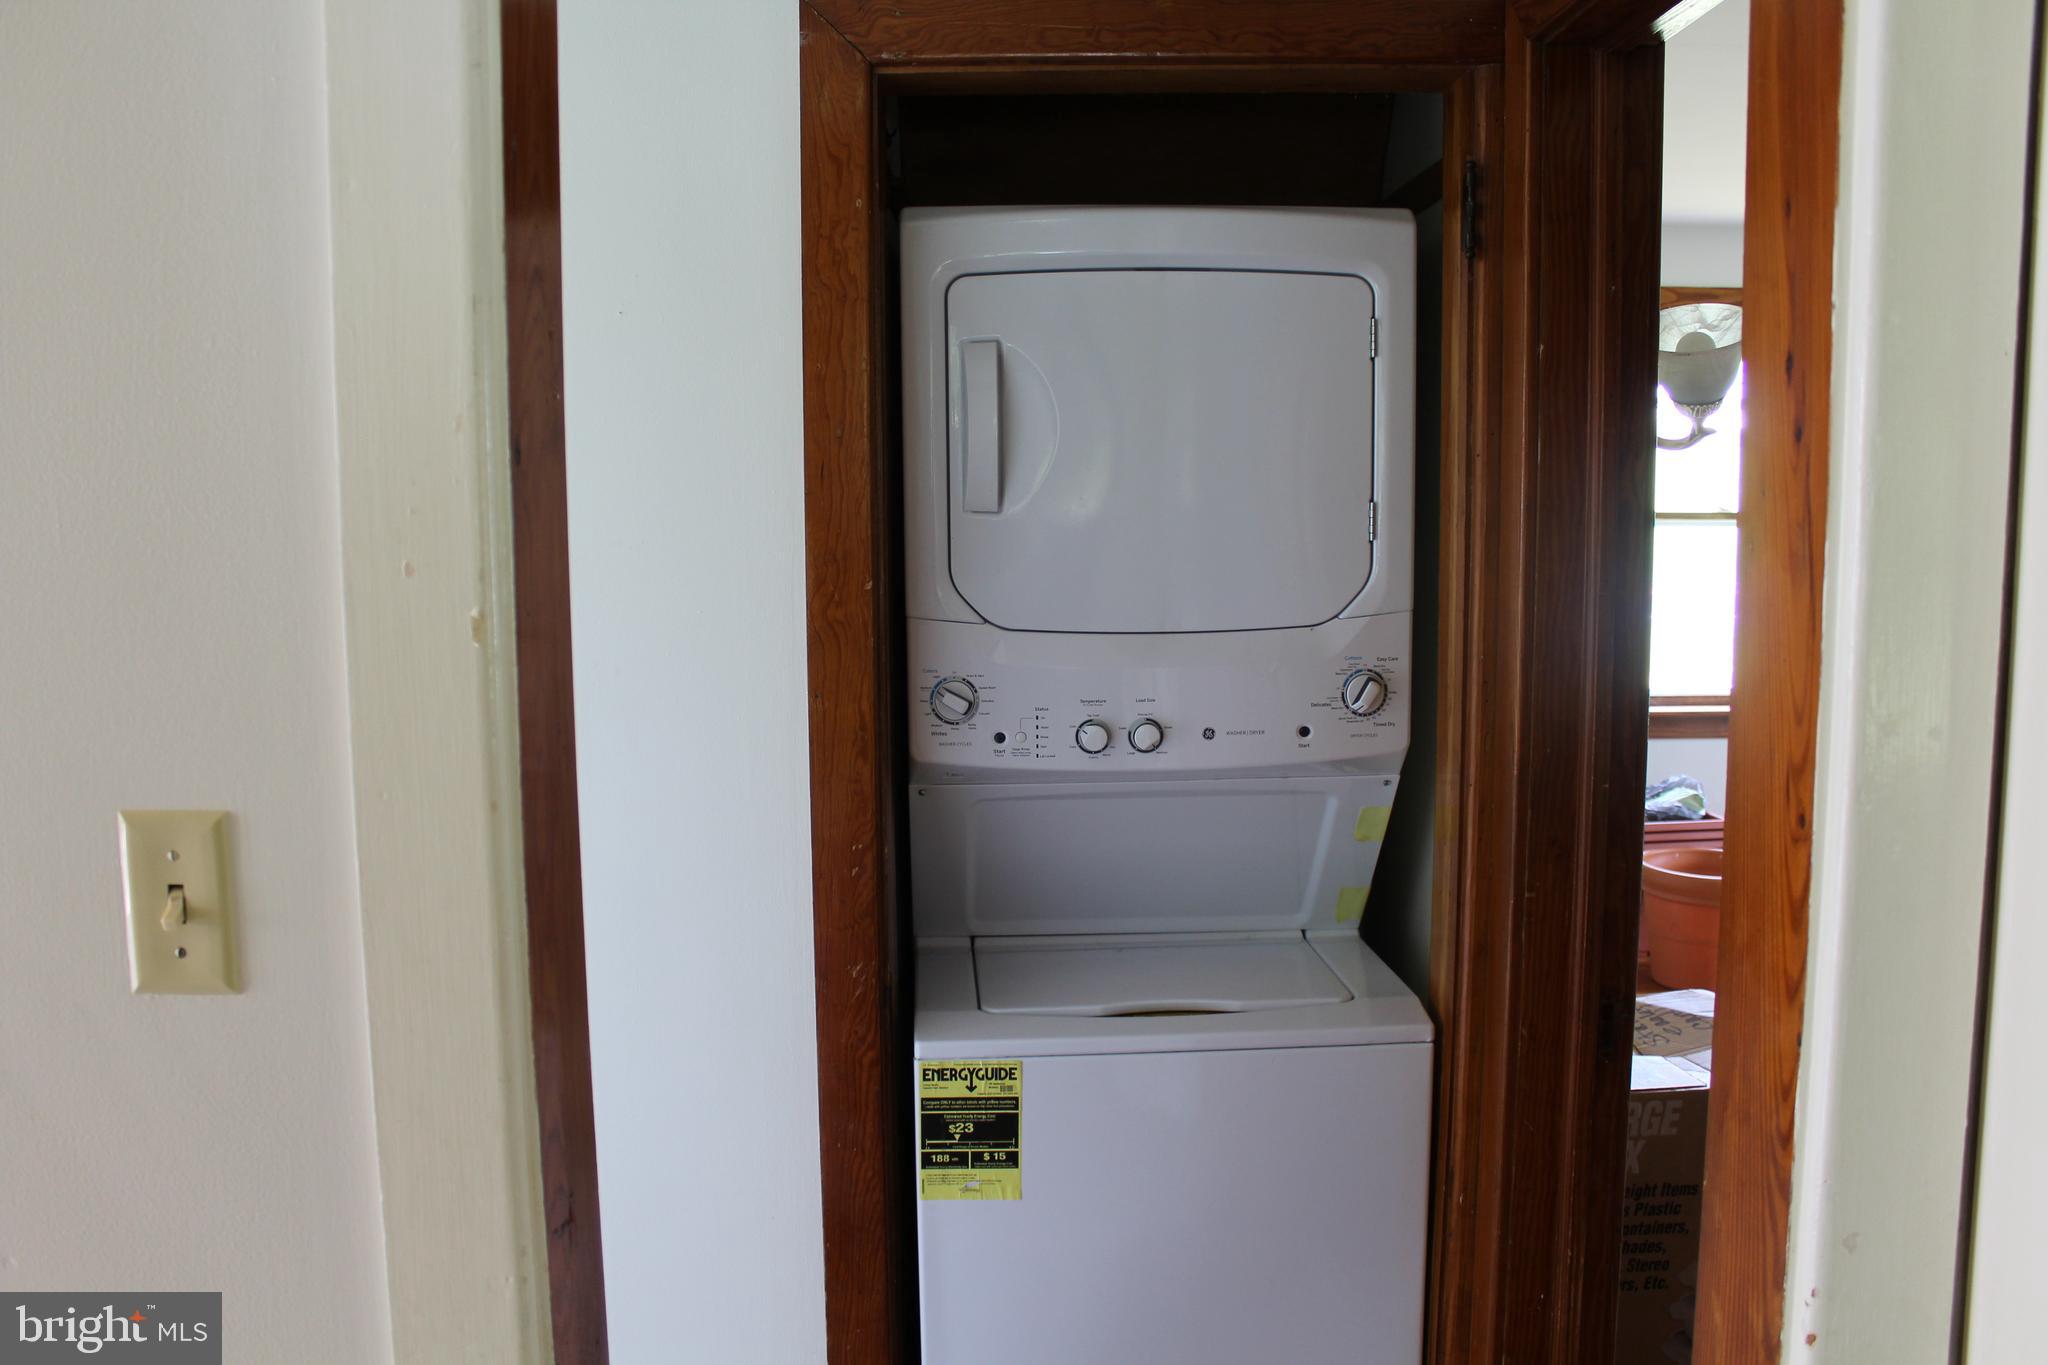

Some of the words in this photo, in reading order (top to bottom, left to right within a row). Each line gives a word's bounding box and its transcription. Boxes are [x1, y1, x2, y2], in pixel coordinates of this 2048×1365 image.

[922, 1067, 1018, 1082] ENERGYGUIDE
[948, 1122, 974, 1133] $23
[931, 1154, 950, 1163] 188
[1660, 1182, 1699, 1196] Items
[1634, 1201, 1682, 1216] Plastic
[1626, 1258, 1670, 1273] Stereo
